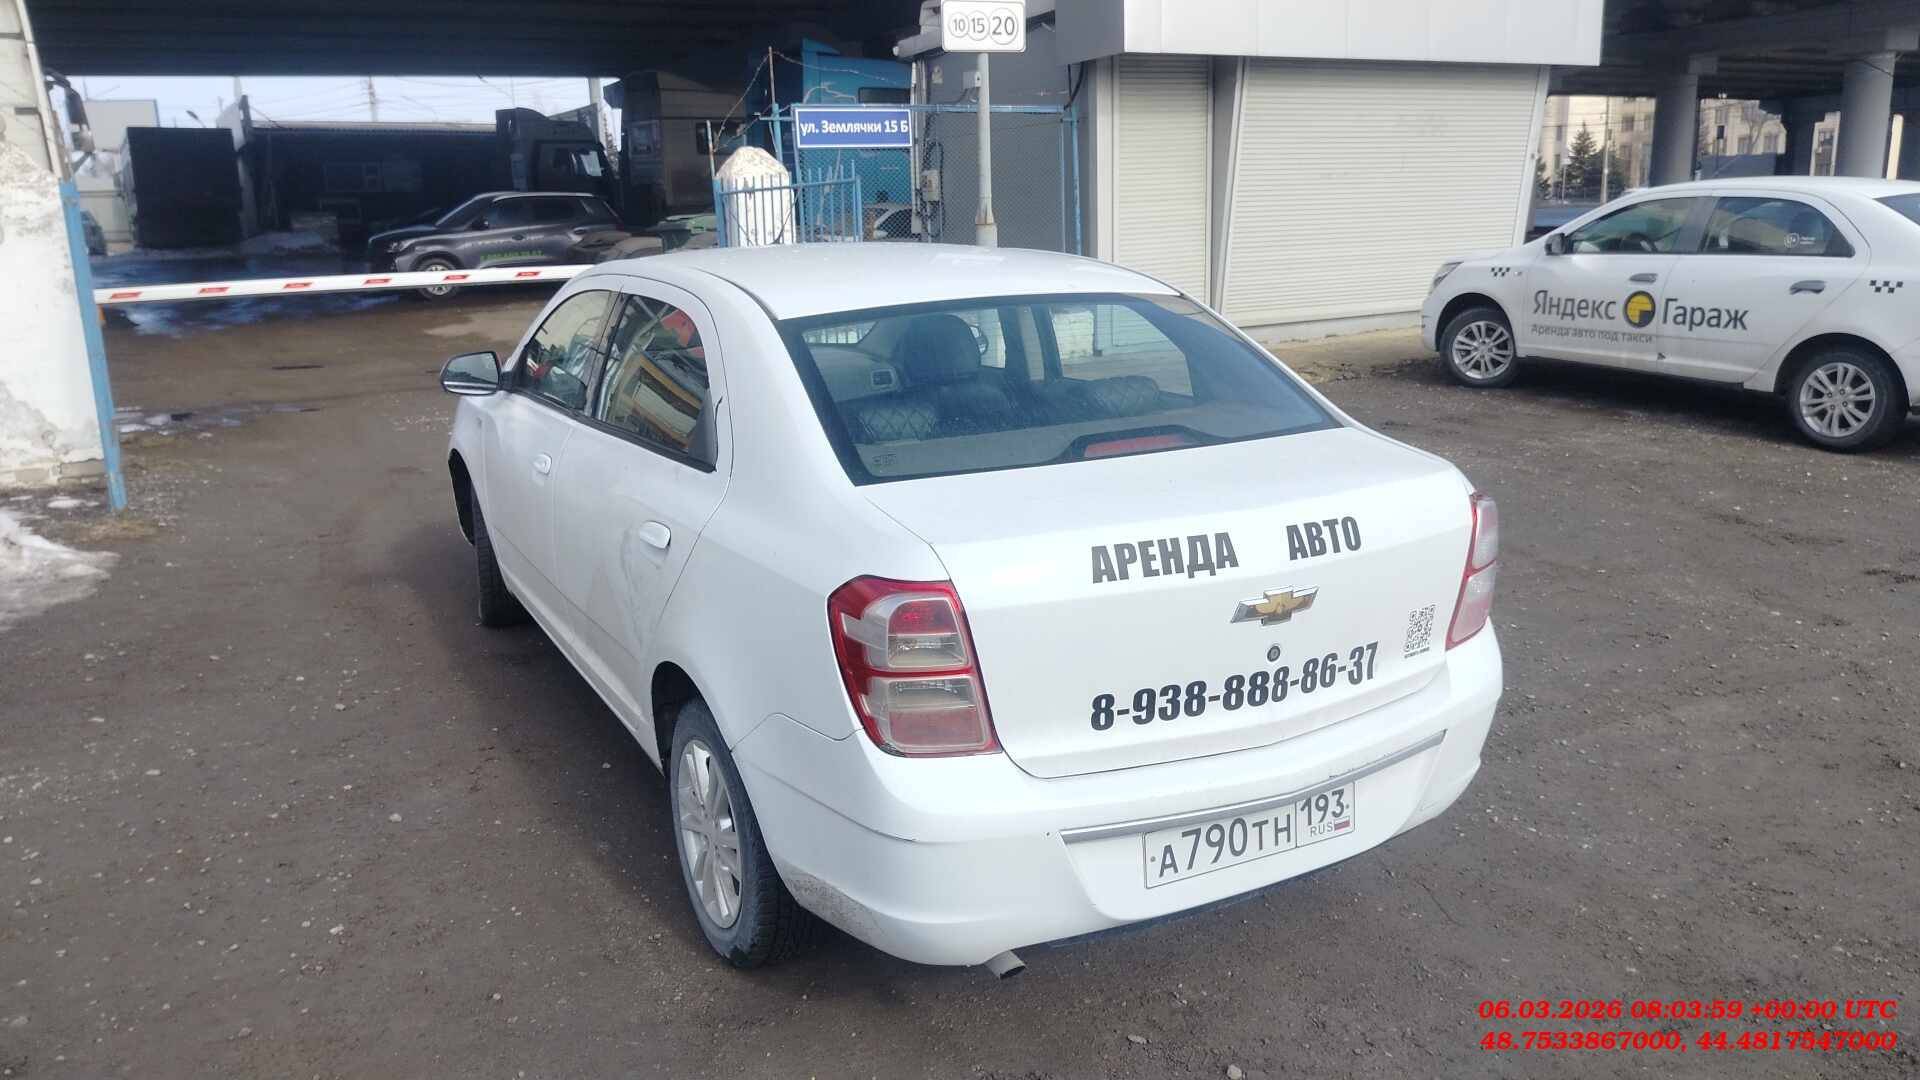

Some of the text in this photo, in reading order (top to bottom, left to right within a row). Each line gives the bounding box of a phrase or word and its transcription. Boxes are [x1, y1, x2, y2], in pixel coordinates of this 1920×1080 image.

[953, 16, 1015, 36] 10 15 20
[800, 120, 909, 136] ул. Землячки 15 Б
[1533, 290, 1749, 331] Яндекс Гараж
[1531, 323, 1653, 343] Аренда авто под такси
[1091, 516, 1361, 583] АРЕНДА АВТО
[1091, 641, 1379, 731] 8-938-888-86-37
[1300, 788, 1344, 825] 193
[1310, 823, 1333, 837] RUS
